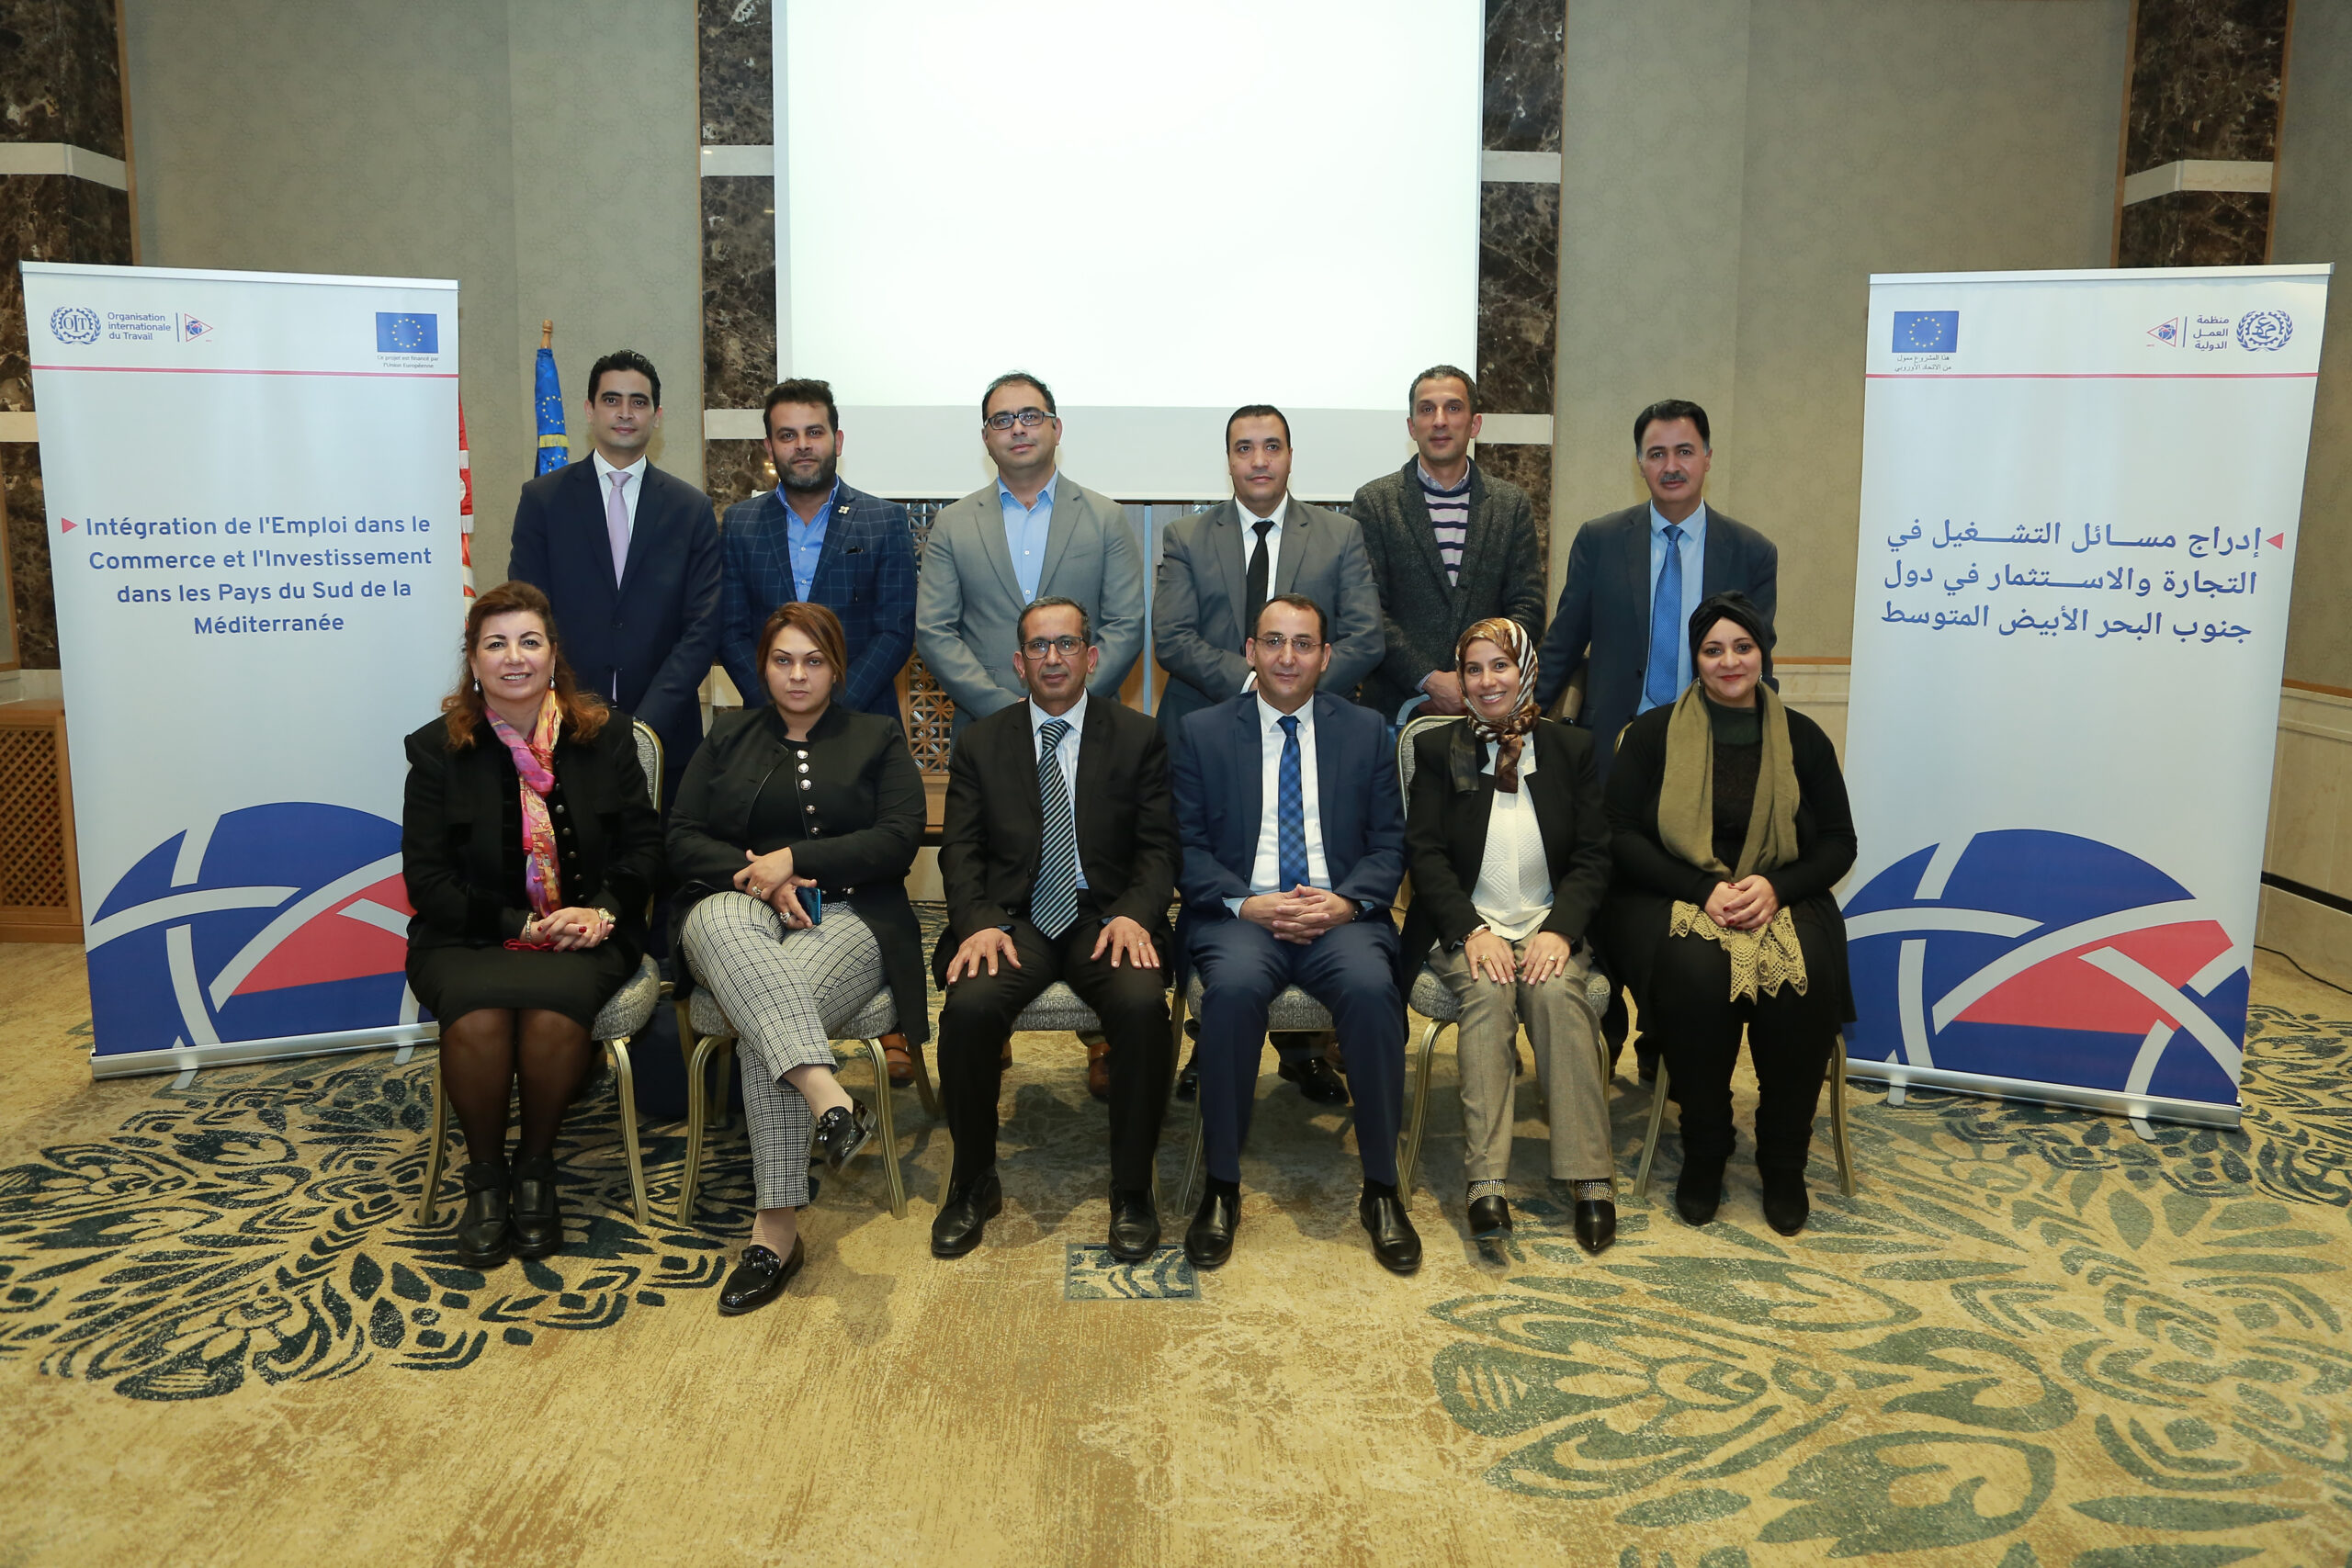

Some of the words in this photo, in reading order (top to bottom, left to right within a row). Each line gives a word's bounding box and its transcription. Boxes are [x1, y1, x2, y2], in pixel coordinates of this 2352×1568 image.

[107, 312, 165, 321] Organisation
[2198, 315, 2229, 323] منظمة
[2193, 329, 2228, 338] العمل
[2195, 341, 2227, 351] الدولية
[87, 517, 216, 539] Intégration
[225, 517, 251, 534] de
[260, 516, 346, 536] l'Emploi
[355, 516, 404, 533] dans
[413, 516, 430, 532] le
[1888, 519, 1921, 552] في
[1933, 519, 2060, 548] التشغيل
[2072, 523, 2176, 553] مسائل
[2189, 526, 2261, 558] إدراج
[90, 552, 215, 569] Commerce
[224, 550, 245, 567] et
[254, 547, 431, 566] l'Investissement
[1884, 559, 1932, 589] دول
[1944, 563, 1978, 596] في
[1987, 564, 2150, 596] والاستثمار
[2164, 570, 2256, 598] التجارة
[118, 586, 171, 603] dans
[179, 585, 210, 601] les
[219, 584, 271, 604] Pays
[279, 582, 305, 599] du
[313, 581, 353, 598] Sud
[361, 581, 386, 597] de
[394, 581, 411, 596] la
[195, 614, 344, 634] Méditerranée
[1882, 601, 1988, 630] المتوسط
[1999, 605, 2087, 637] الأبيض
[2096, 613, 2162, 640] البحر
[2173, 621, 2251, 643] جنوب
